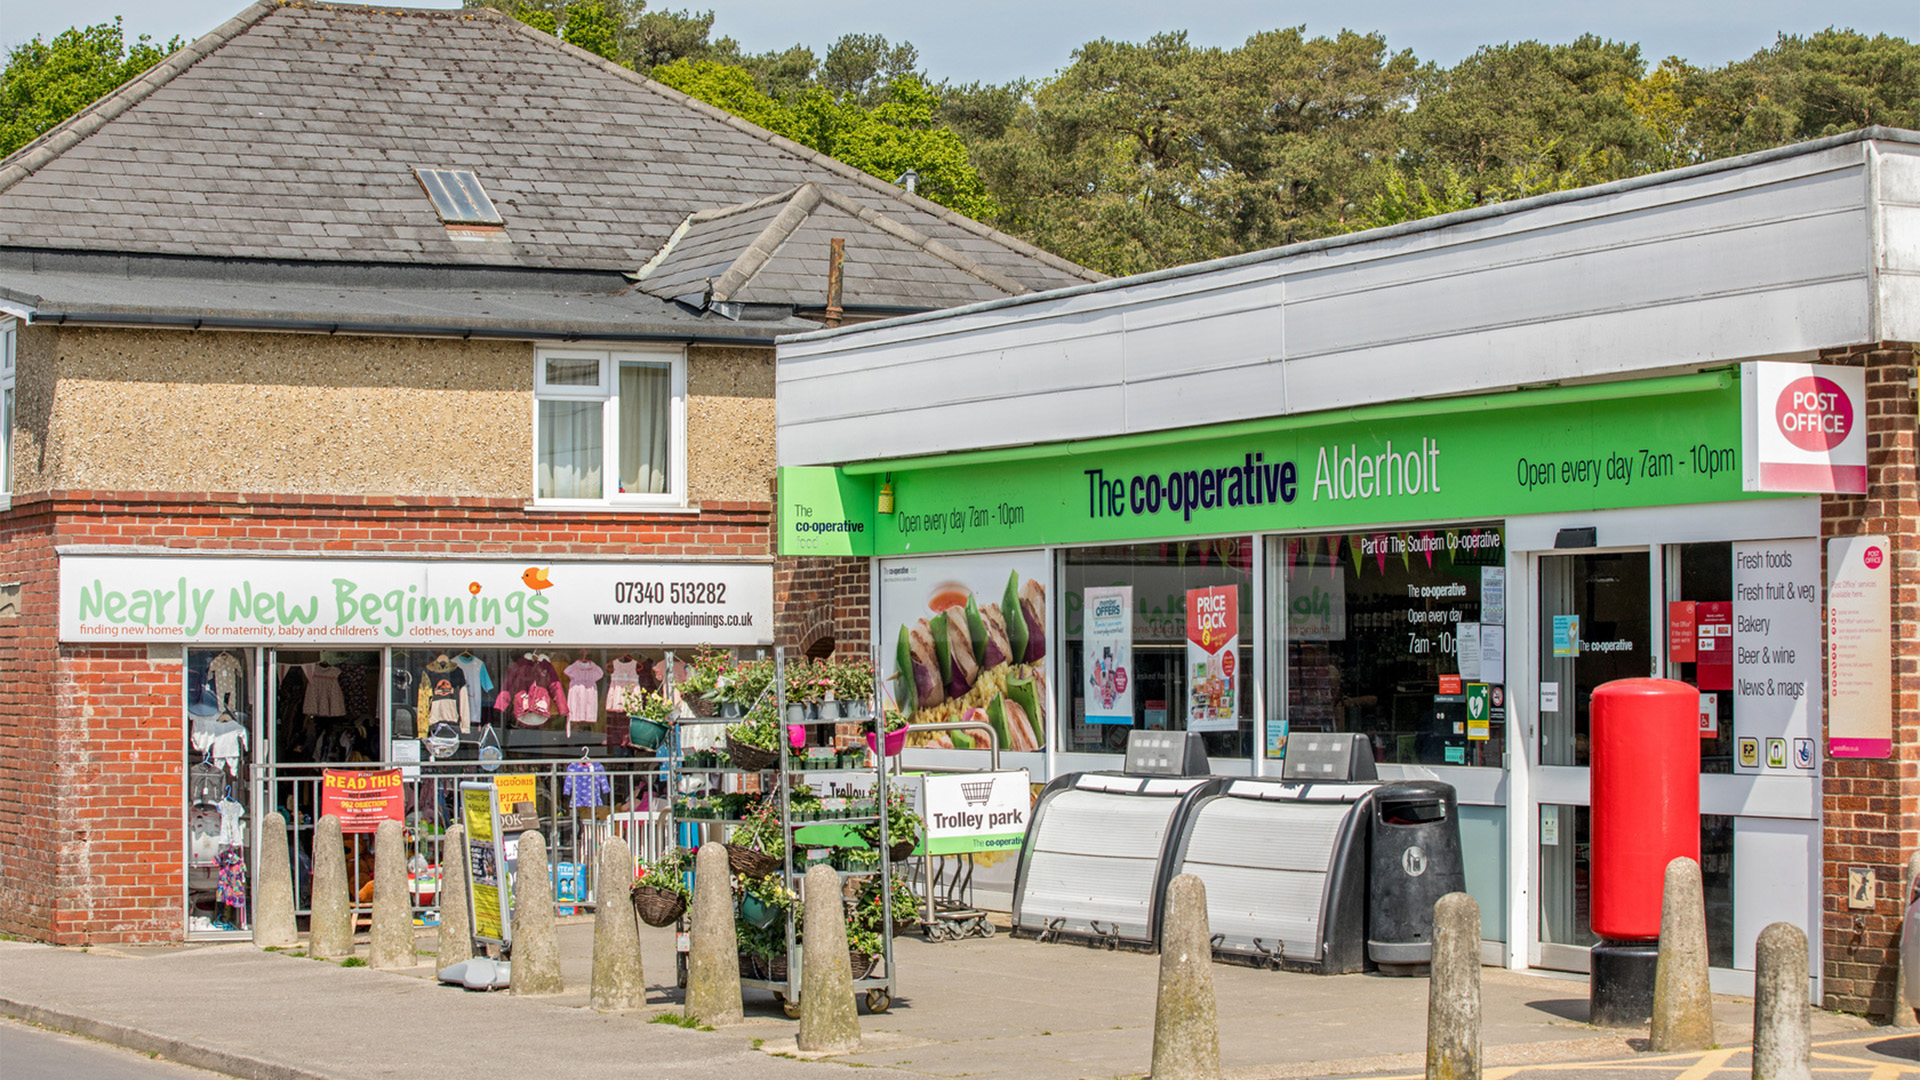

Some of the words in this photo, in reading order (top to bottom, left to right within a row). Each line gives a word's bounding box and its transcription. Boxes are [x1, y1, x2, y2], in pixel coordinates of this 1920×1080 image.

[1794, 392, 1838, 412] POST
[1783, 412, 1845, 434] OFFICE
[1313, 437, 1441, 501] Alderholt
[1517, 458, 1556, 491] Open
[1561, 460, 1600, 488] every
[1606, 451, 1633, 486] day
[1638, 449, 1673, 478] 7am
[1690, 444, 1735, 480] 10pm
[1084, 469, 1125, 518] The
[1130, 452, 1297, 522] co-operative
[794, 504, 813, 518] The
[898, 510, 921, 537] Open
[924, 513, 948, 535] every
[950, 508, 966, 533] day
[968, 506, 989, 528] 7am
[998, 502, 1024, 530] 10pm
[796, 520, 864, 536] co-operative
[796, 536, 818, 549] food
[1361, 538, 1378, 555] Part
[1380, 536, 1388, 553] of
[1390, 536, 1406, 552] The
[1408, 534, 1444, 552] Southern
[1446, 532, 1500, 552] Co-operative
[1737, 552, 1763, 570] Fresh
[1766, 550, 1792, 568] foods
[1868, 550, 1880, 558] POST
[615, 582, 664, 604] 07340
[670, 582, 726, 604] 513282
[1408, 584, 1420, 598] The
[1421, 582, 1466, 600] co-operative
[1737, 584, 1764, 600] Fresh
[1765, 582, 1785, 600] fruit
[1787, 582, 1796, 599] &
[1798, 584, 1815, 603] veg
[79, 576, 215, 637] Nearly
[229, 580, 319, 626] New
[332, 578, 549, 638] Beginnings
[1096, 604, 1121, 616] OFFERS
[1197, 594, 1226, 613] PRICE
[593, 611, 753, 628] www.nearlynewbeginnings.co.uk
[1198, 612, 1226, 630] LOCK
[1408, 610, 1427, 625] Open
[1428, 610, 1448, 624] every
[1448, 608, 1463, 623] day
[1738, 615, 1770, 636] Bakery
[80, 624, 119, 637] finding
[121, 626, 144, 635] new
[146, 624, 184, 635] homes
[204, 624, 220, 636] for
[222, 624, 276, 637] maternity,
[278, 625, 306, 638] baby
[307, 626, 327, 636] and
[330, 625, 379, 636] children's
[410, 626, 450, 638] clothes,
[452, 627, 473, 638] toys
[474, 626, 495, 636] and
[527, 628, 554, 637] more
[1408, 633, 1430, 654] 7am
[1438, 632, 1458, 657] 10p
[1579, 640, 1590, 650] The
[1591, 639, 1633, 653] co-operative
[1738, 648, 1760, 665] Beer
[1762, 647, 1770, 664] &
[1772, 646, 1796, 664] wine
[1738, 678, 1765, 696] News
[1767, 678, 1775, 696] &
[1777, 682, 1804, 700] mags
[326, 775, 367, 790] READ
[370, 774, 402, 788] THIS
[496, 778, 534, 787] LIGUORIS
[500, 793, 530, 802] PIZZA
[934, 812, 984, 830] Trolley
[989, 808, 1023, 827] park
[973, 838, 984, 848] The
[985, 837, 1024, 848] co-operativ
